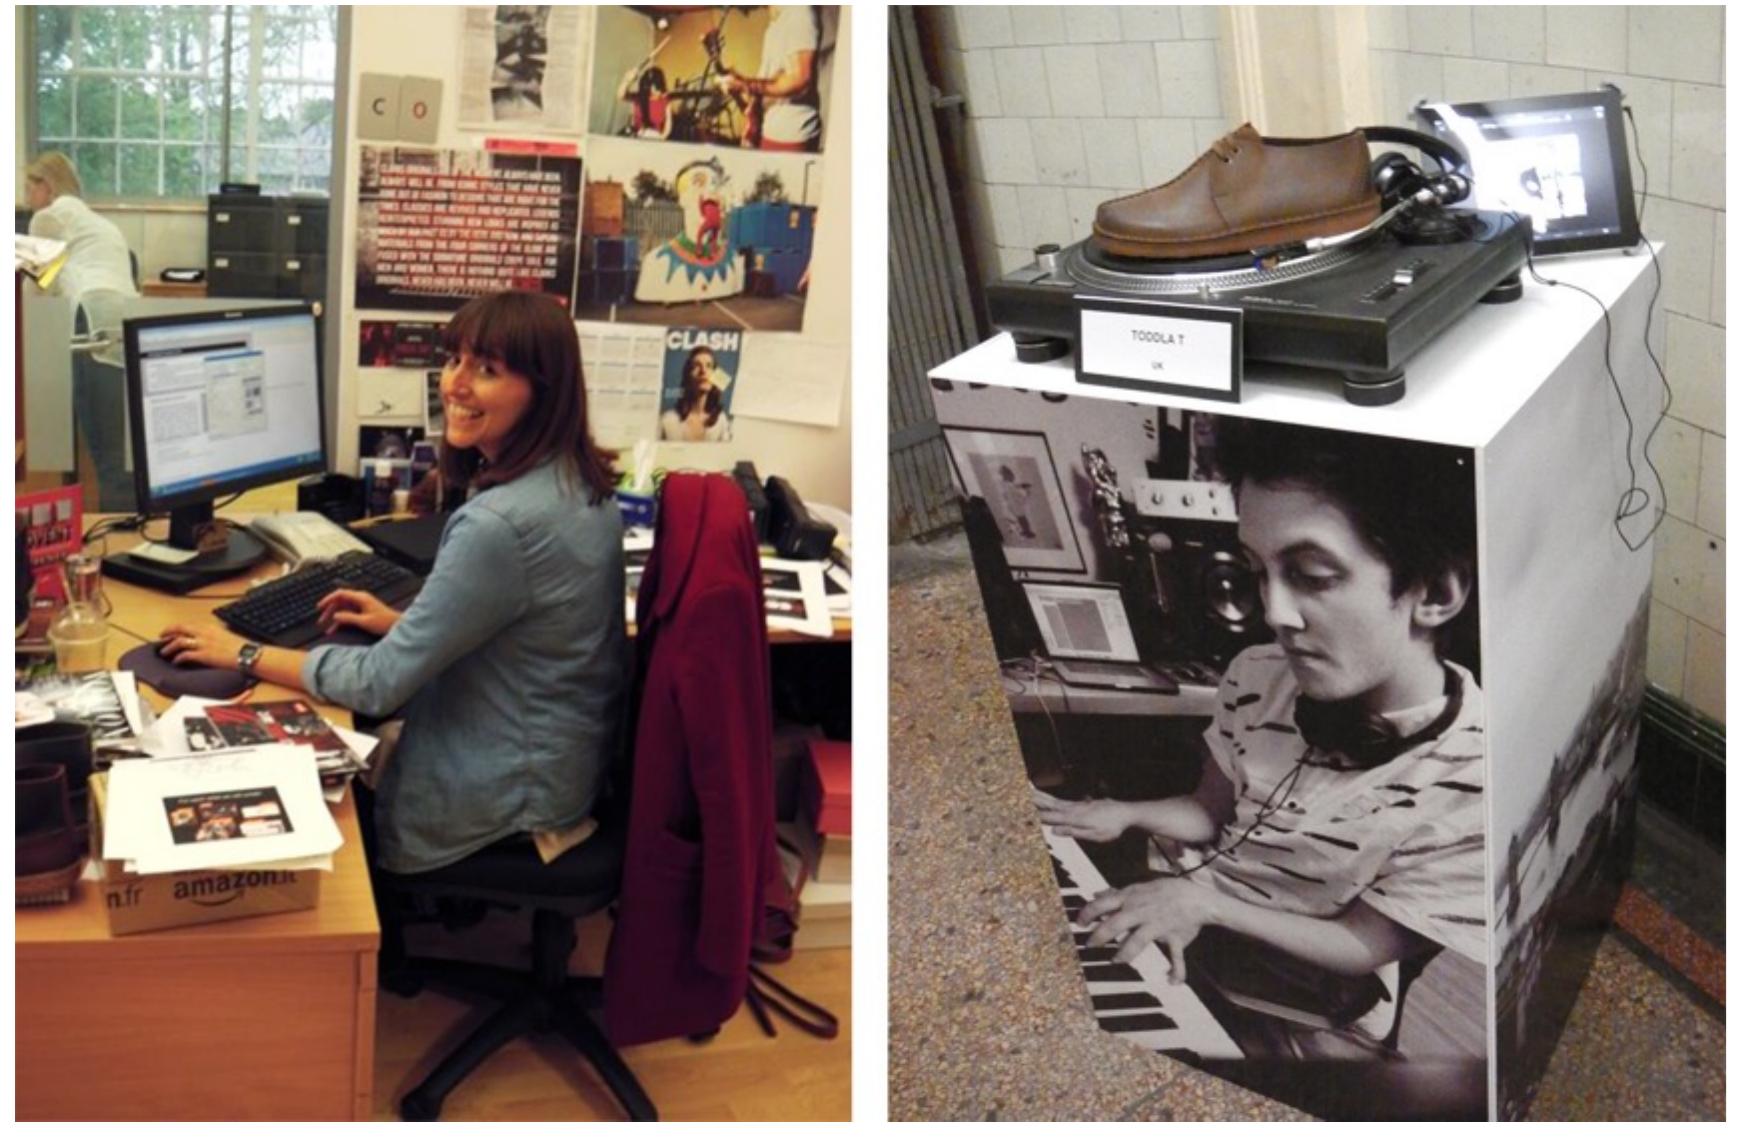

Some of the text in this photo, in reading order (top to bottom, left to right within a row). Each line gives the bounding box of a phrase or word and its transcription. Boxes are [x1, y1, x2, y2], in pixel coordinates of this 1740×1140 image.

[372, 97, 428, 119] C O
[668, 330, 740, 351] CLASH
[1178, 334, 1184, 346] T
